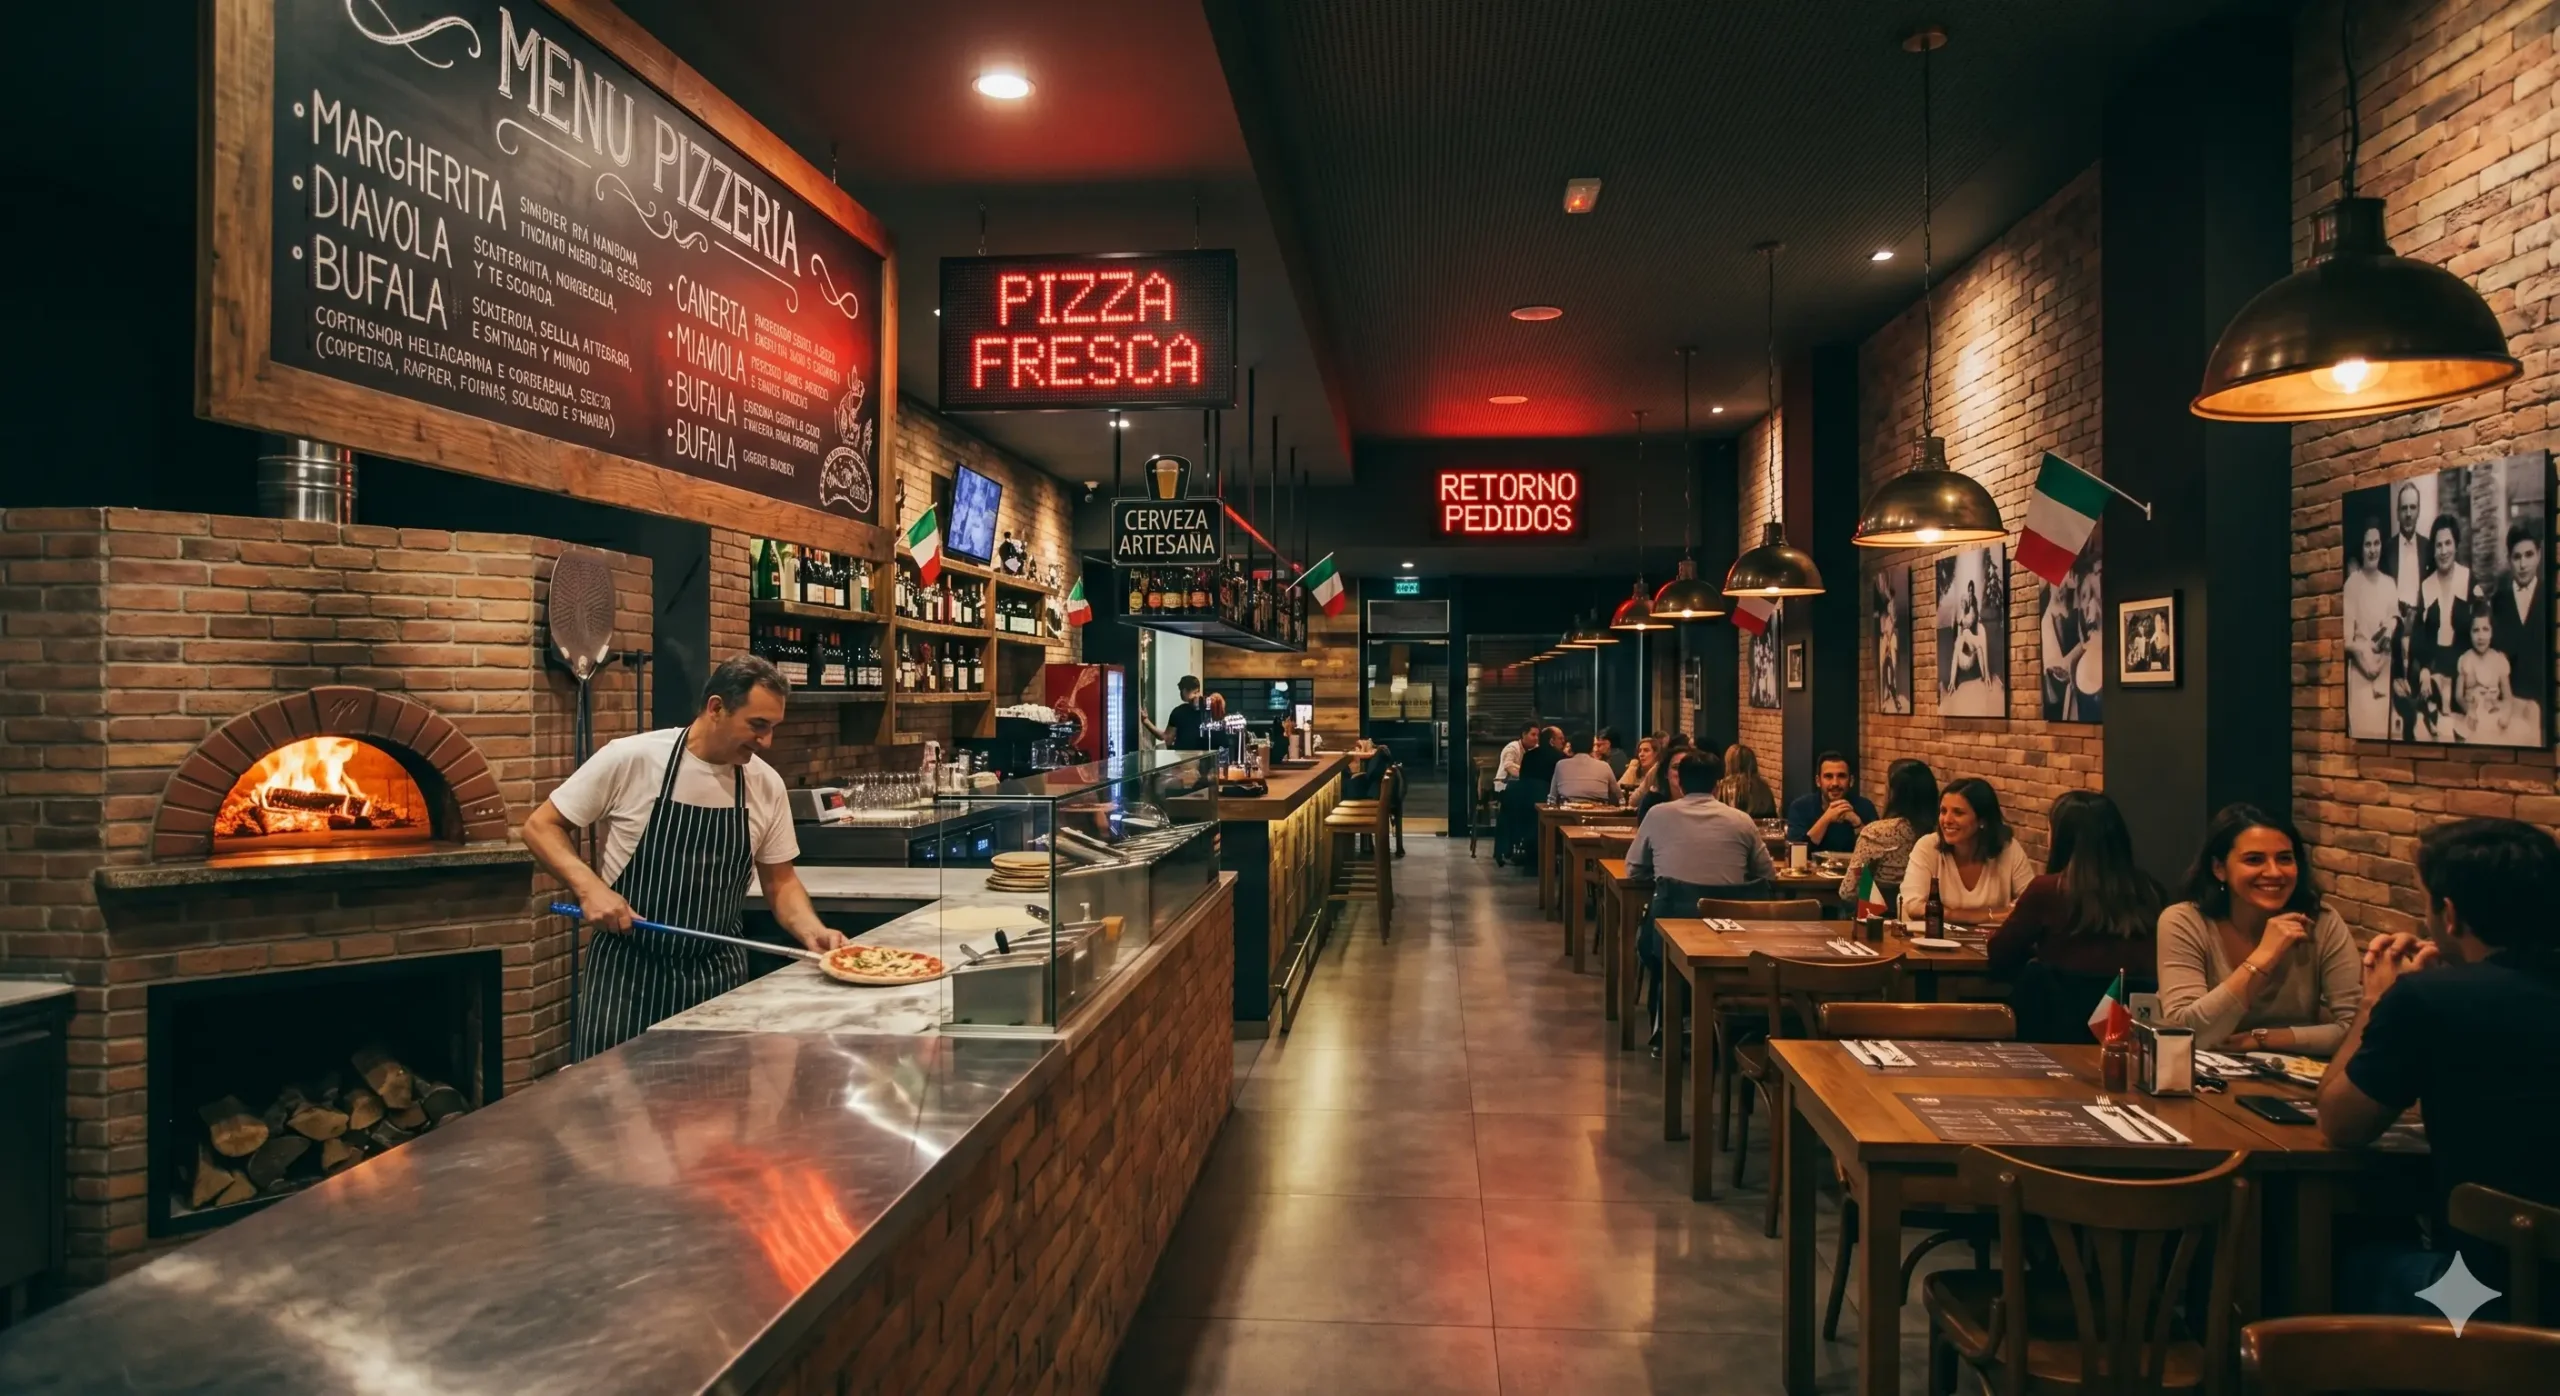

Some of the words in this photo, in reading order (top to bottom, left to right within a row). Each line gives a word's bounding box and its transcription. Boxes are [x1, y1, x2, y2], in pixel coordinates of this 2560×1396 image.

[313, 88, 507, 231] MARGHERITA
[498, 6, 635, 168] MENU
[652, 115, 802, 278] PIZZERIA
[315, 164, 453, 269] DIAVOLA
[315, 233, 448, 331] BUFALA
[473, 260, 484, 279] Y
[676, 274, 749, 342] CANERTA
[1000, 271, 1172, 326] PIZZA
[472, 320, 480, 340] E
[540, 346, 550, 363] Y
[973, 333, 1199, 388] FRESCA
[497, 362, 505, 379] E
[676, 370, 737, 427] BUFALA
[676, 418, 737, 472] BUFALA
[1440, 472, 1577, 501] RETORNO
[1124, 508, 1209, 531] CERVEZA
[1445, 503, 1573, 532] PEDIDOS
